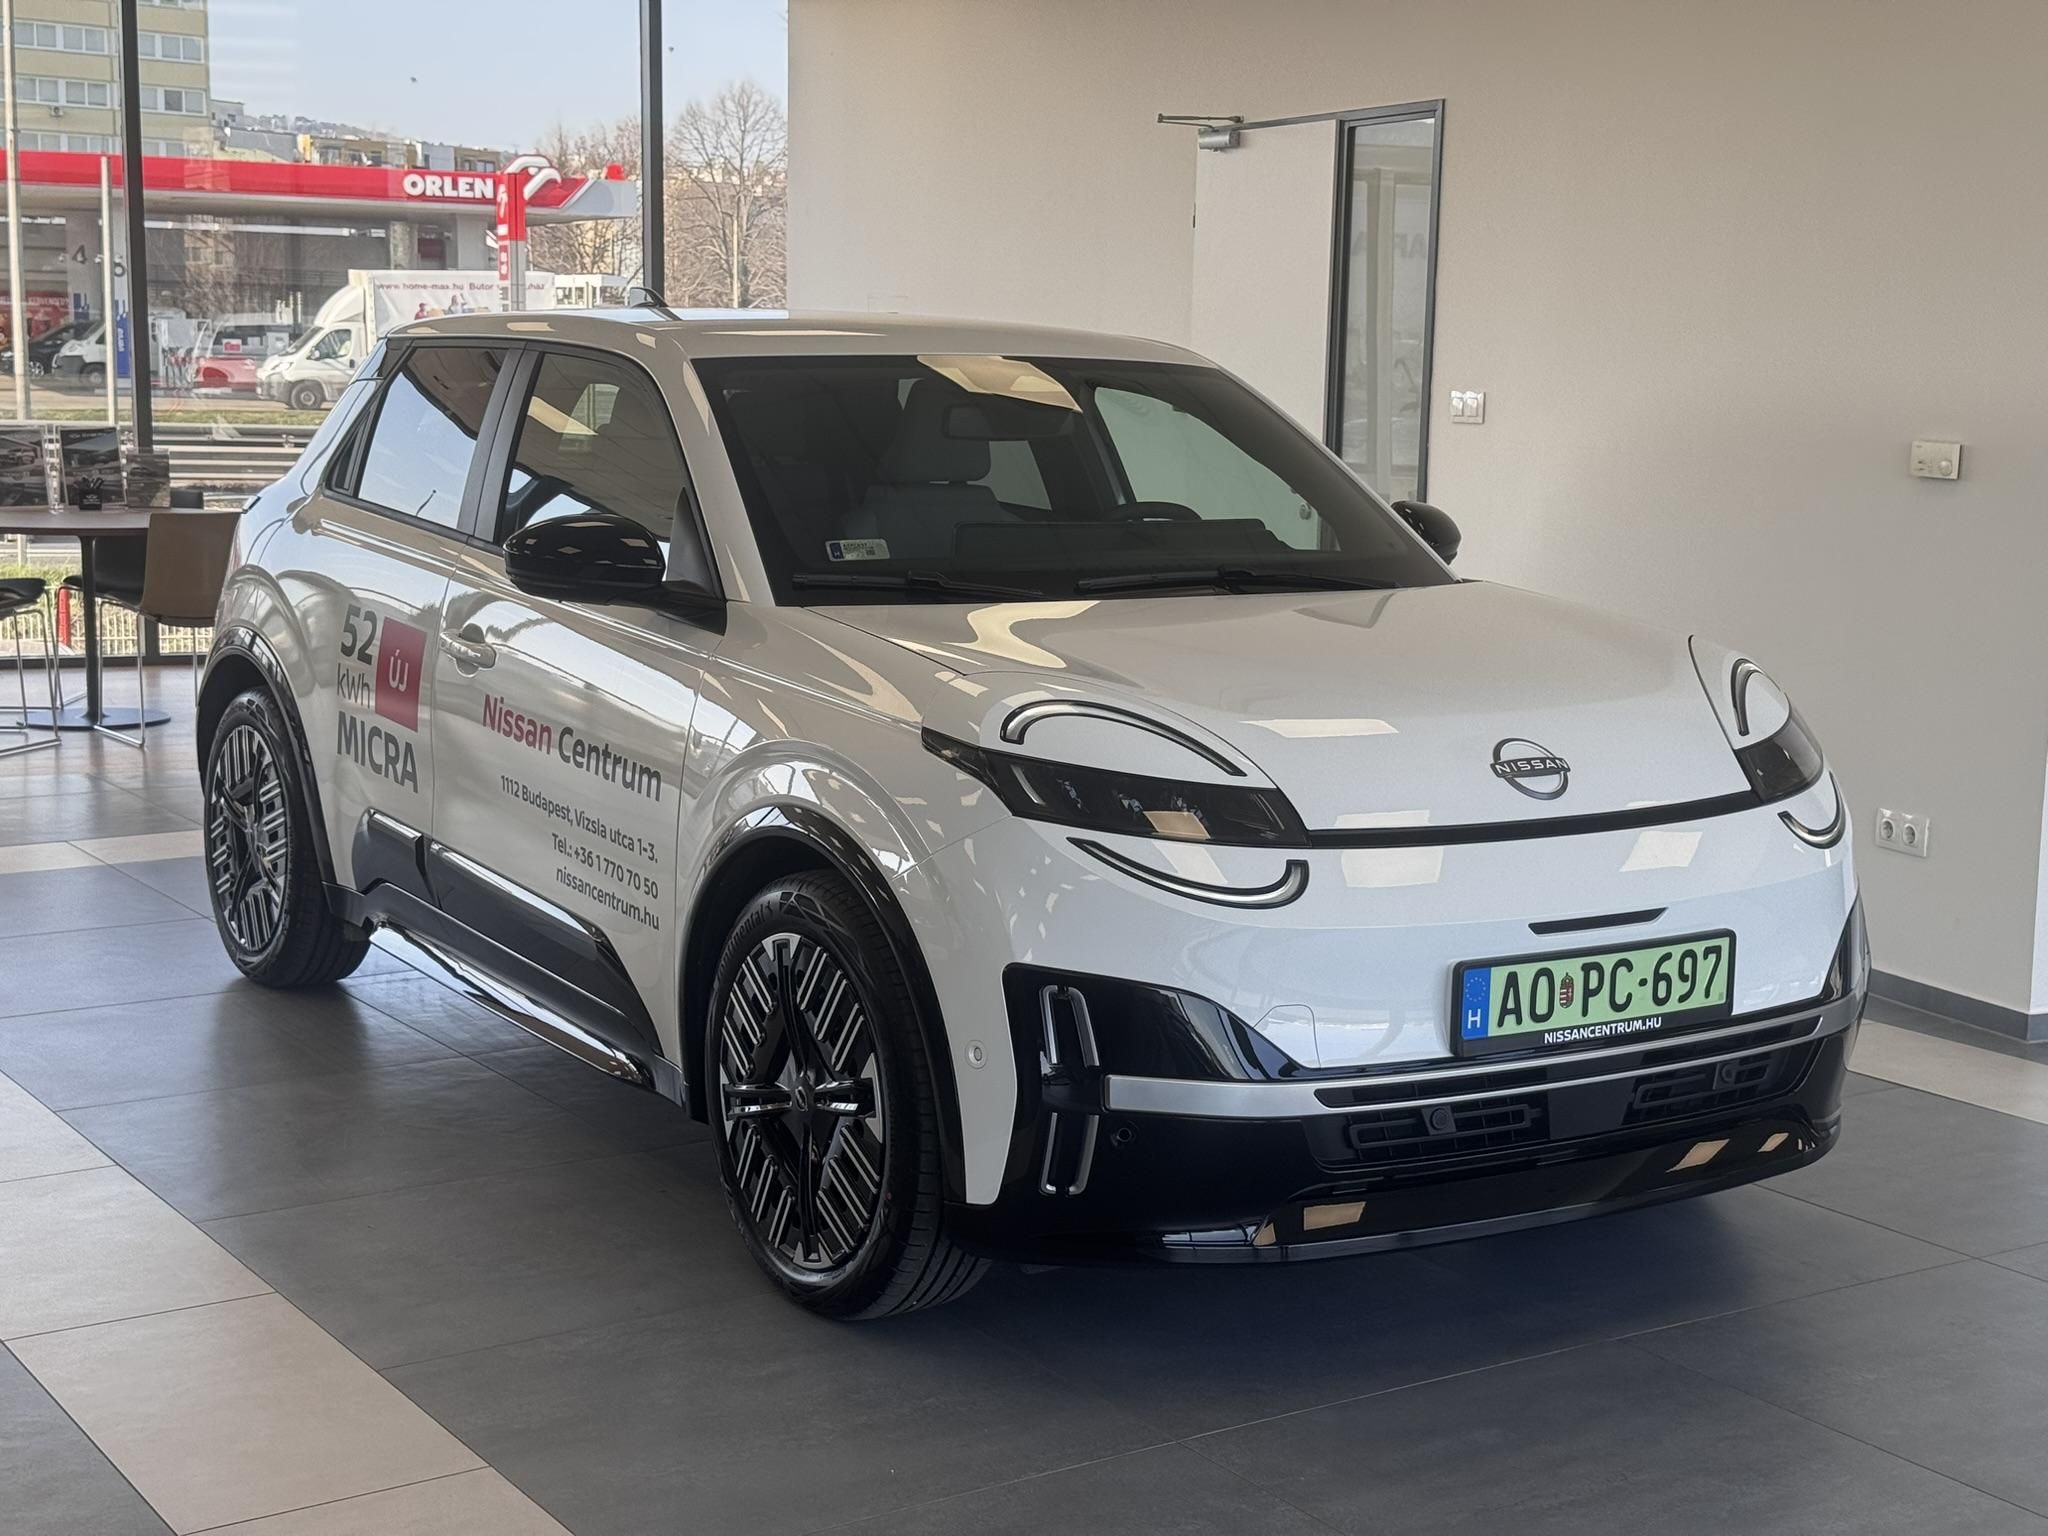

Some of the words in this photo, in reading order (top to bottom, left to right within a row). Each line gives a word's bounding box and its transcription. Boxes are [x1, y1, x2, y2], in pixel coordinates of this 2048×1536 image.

[403, 174, 493, 199] ORLEN
[72, 245, 87, 264] 4
[340, 604, 378, 666] 52
[337, 664, 370, 709] kWh
[388, 649, 409, 692] ÚJ
[337, 711, 418, 794] MICRA
[482, 694, 552, 755] Nissan
[558, 726, 662, 802] Centrum
[1495, 759, 1569, 774] NISSAN
[501, 775, 520, 798] 1112
[522, 784, 574, 827] Budapest,
[574, 808, 607, 840] Vizsla
[610, 828, 635, 852] utca
[637, 838, 658, 863] 1-3.
[552, 832, 572, 858] Tel.:
[574, 846, 594, 868] +36
[596, 855, 601, 872] 1
[603, 858, 624, 883] 770
[626, 869, 641, 890] 70
[644, 877, 659, 900] 50
[556, 866, 660, 930] nissancentrum.hu
[1467, 1008, 1481, 1029] H
[1544, 1016, 1662, 1044] NISSANCENTRUM.HU
